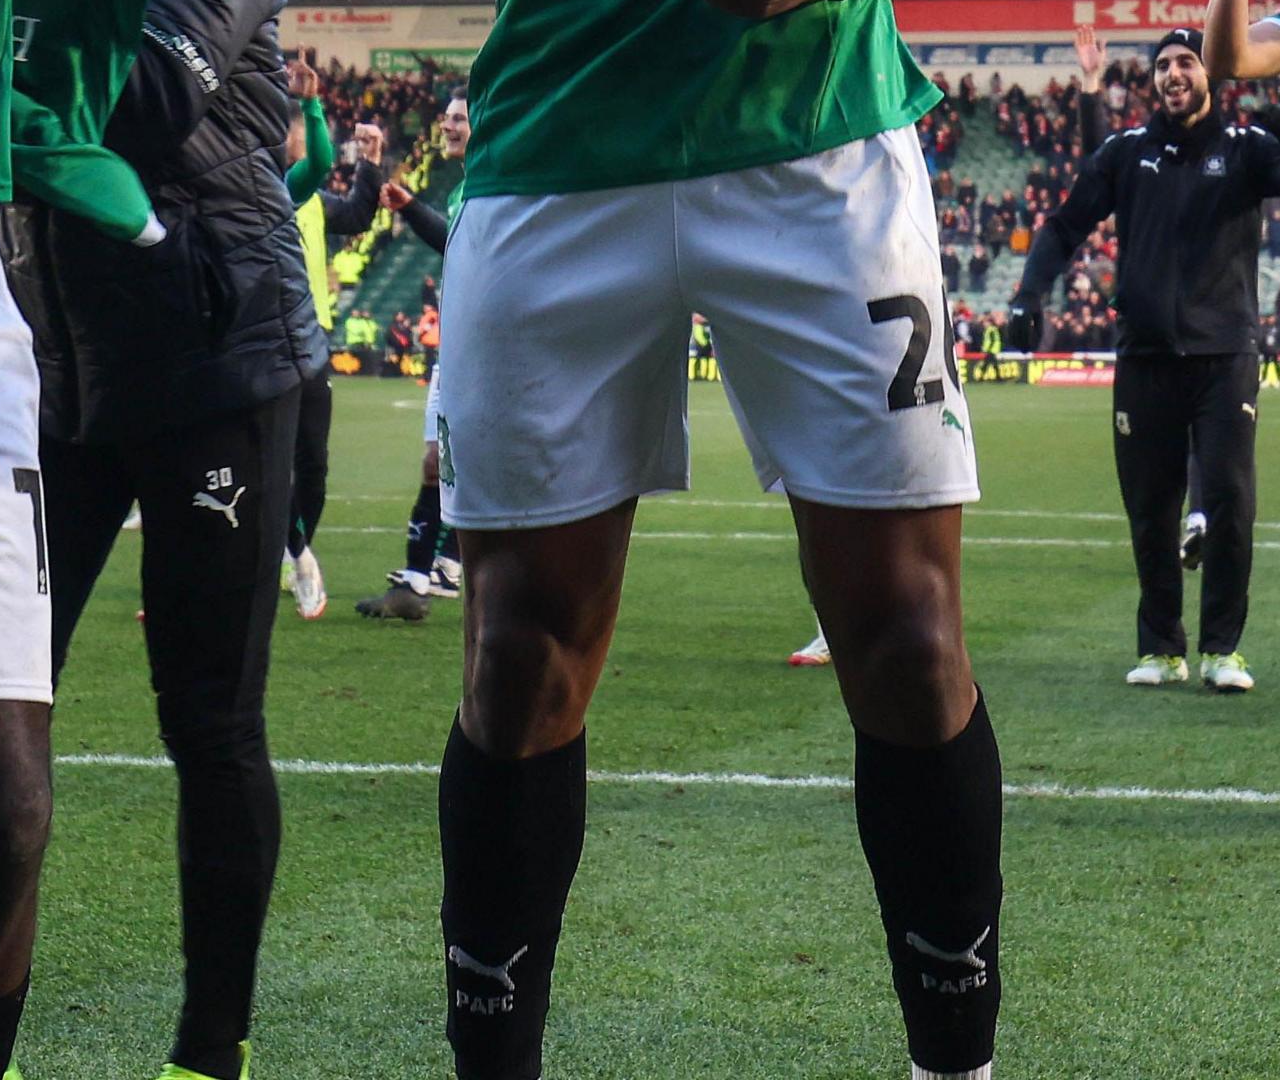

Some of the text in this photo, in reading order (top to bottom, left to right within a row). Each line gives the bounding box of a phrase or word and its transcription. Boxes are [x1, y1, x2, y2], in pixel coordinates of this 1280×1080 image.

[206, 467, 233, 491] 30
[921, 970, 988, 995] PAFC
[456, 988, 515, 1016] PAFC
